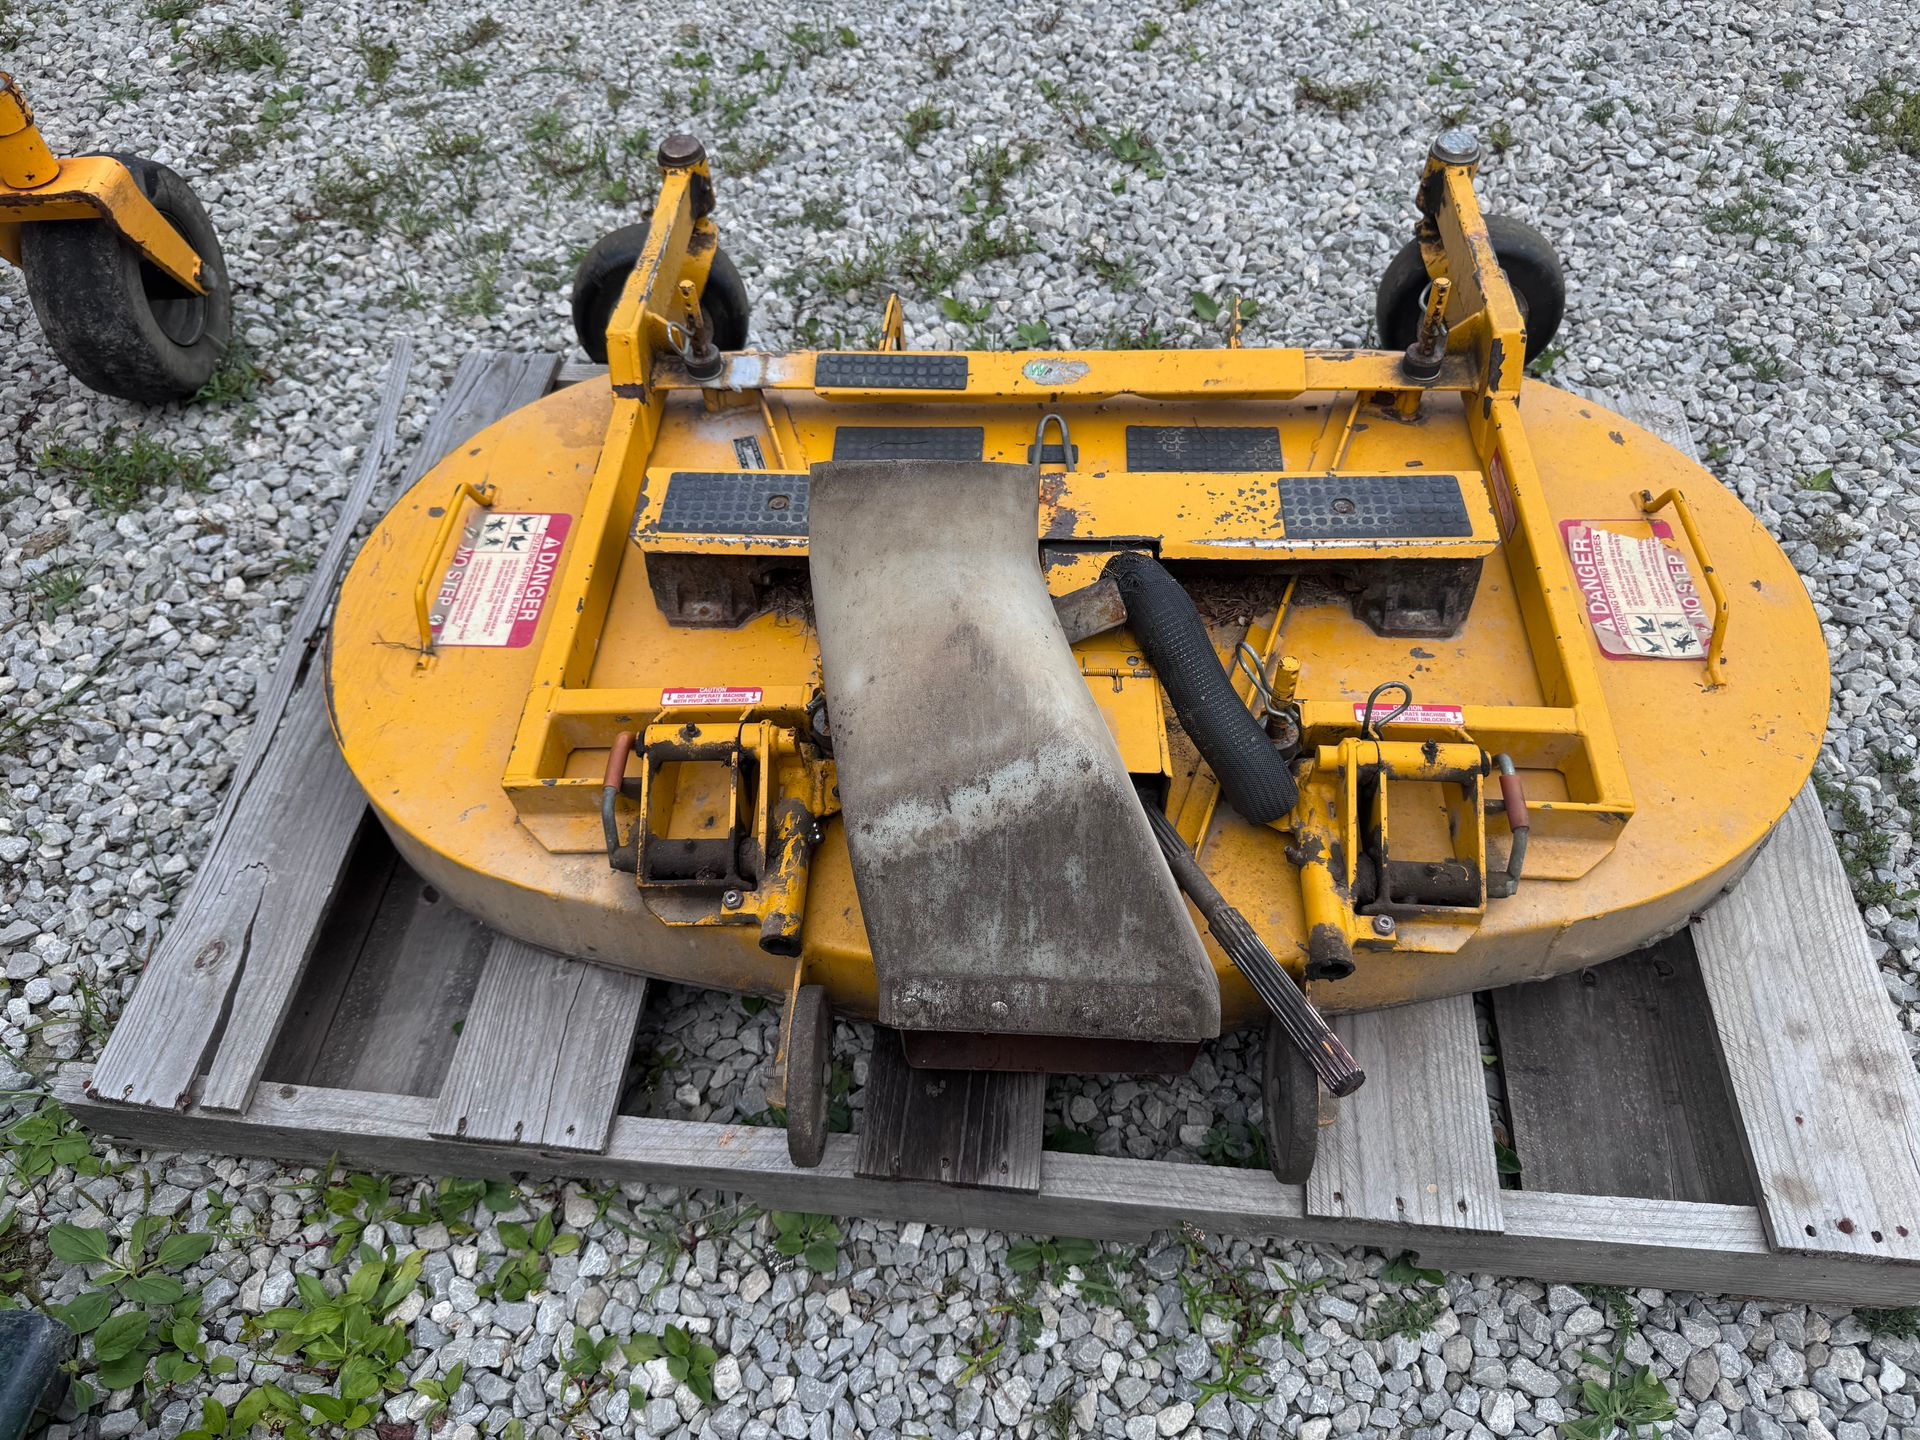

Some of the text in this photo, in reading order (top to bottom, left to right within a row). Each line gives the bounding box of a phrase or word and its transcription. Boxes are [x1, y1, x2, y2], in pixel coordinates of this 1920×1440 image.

[438, 571, 463, 606] STEP
[453, 545, 474, 567] NO
[504, 533, 543, 623] ROTATING CUTTING BLADES
[518, 552, 557, 621] DANGER
[1573, 538, 1608, 615] DANGER
[1593, 535, 1630, 635] ROTATING CUTTING BLADES
[1668, 555, 1706, 618] NO STEP
